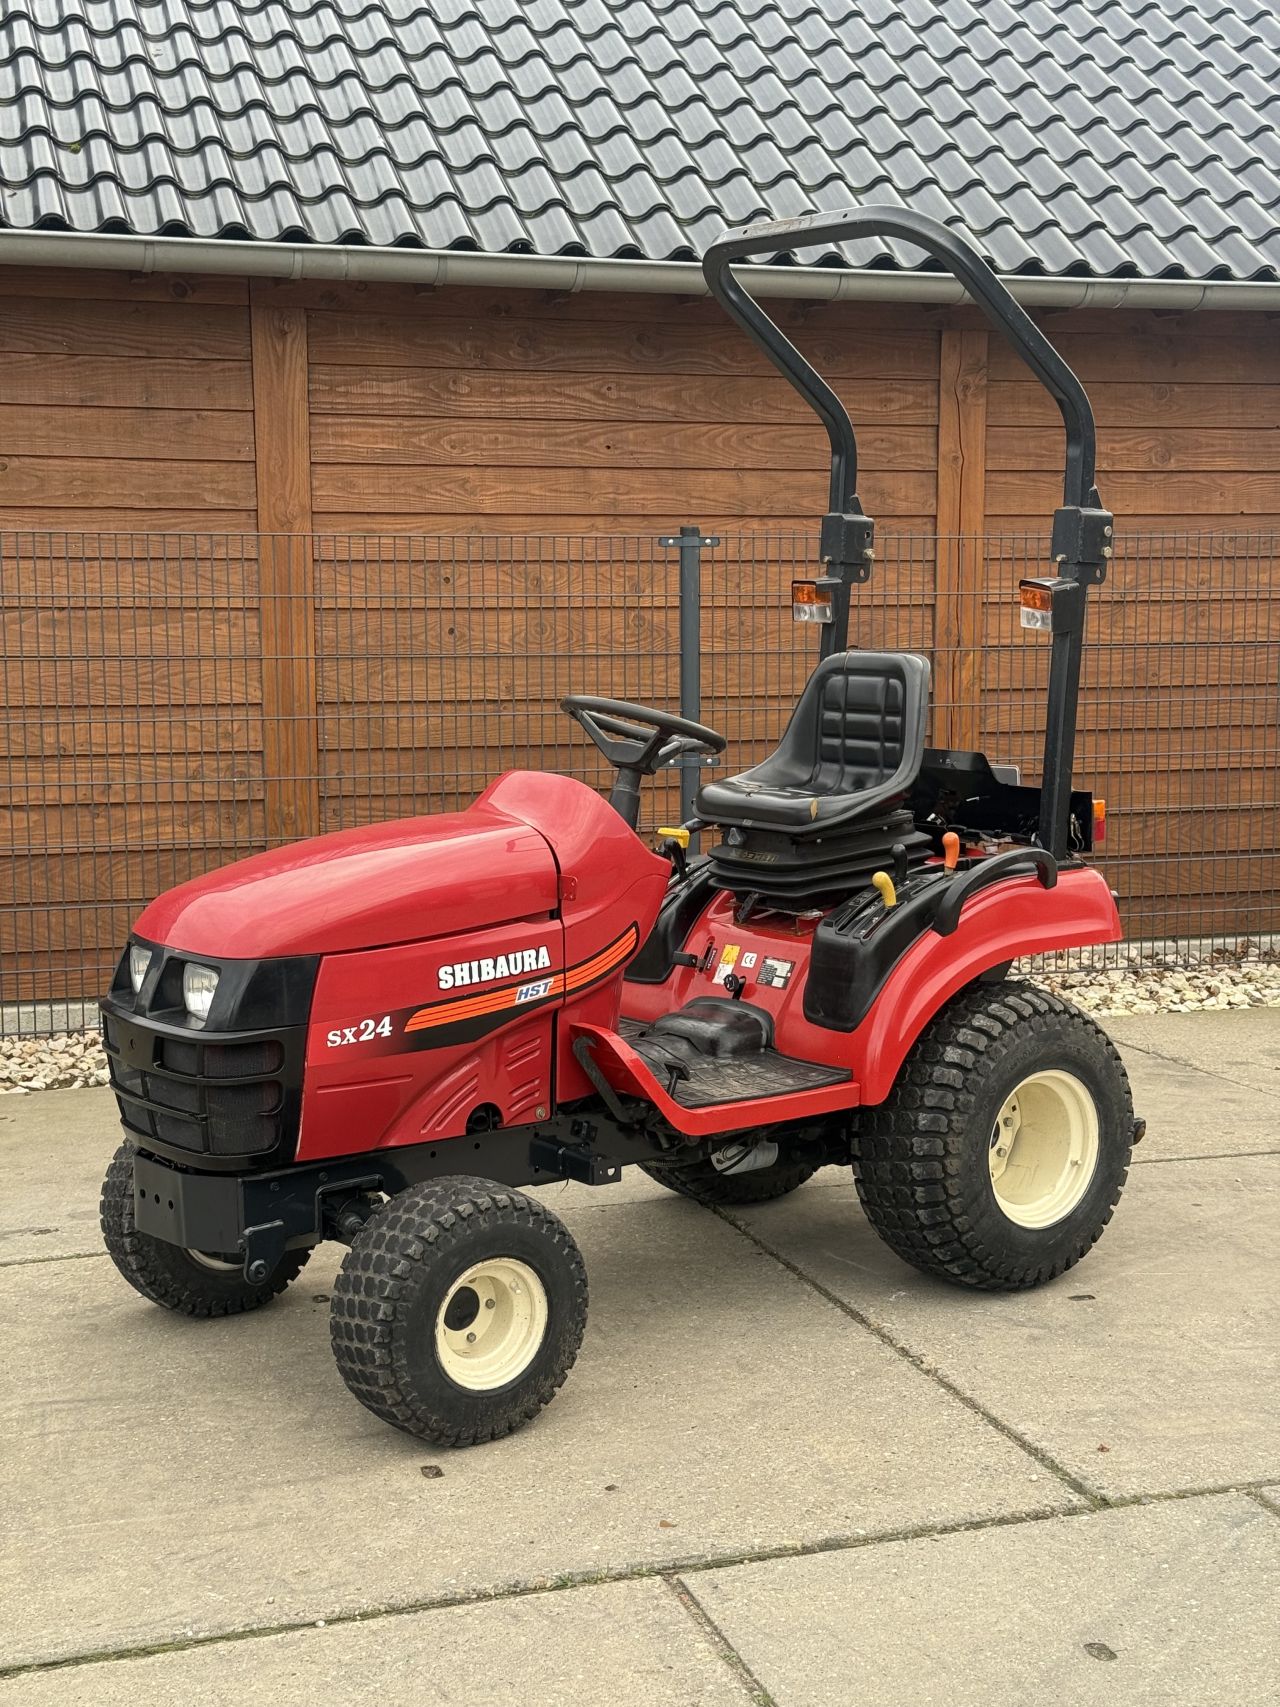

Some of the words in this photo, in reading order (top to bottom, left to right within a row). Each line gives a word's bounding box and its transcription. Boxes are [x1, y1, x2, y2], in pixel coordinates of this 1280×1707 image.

[438, 945, 550, 990] SHIBAURA
[744, 954, 755, 965] CE
[516, 980, 553, 1001] HST
